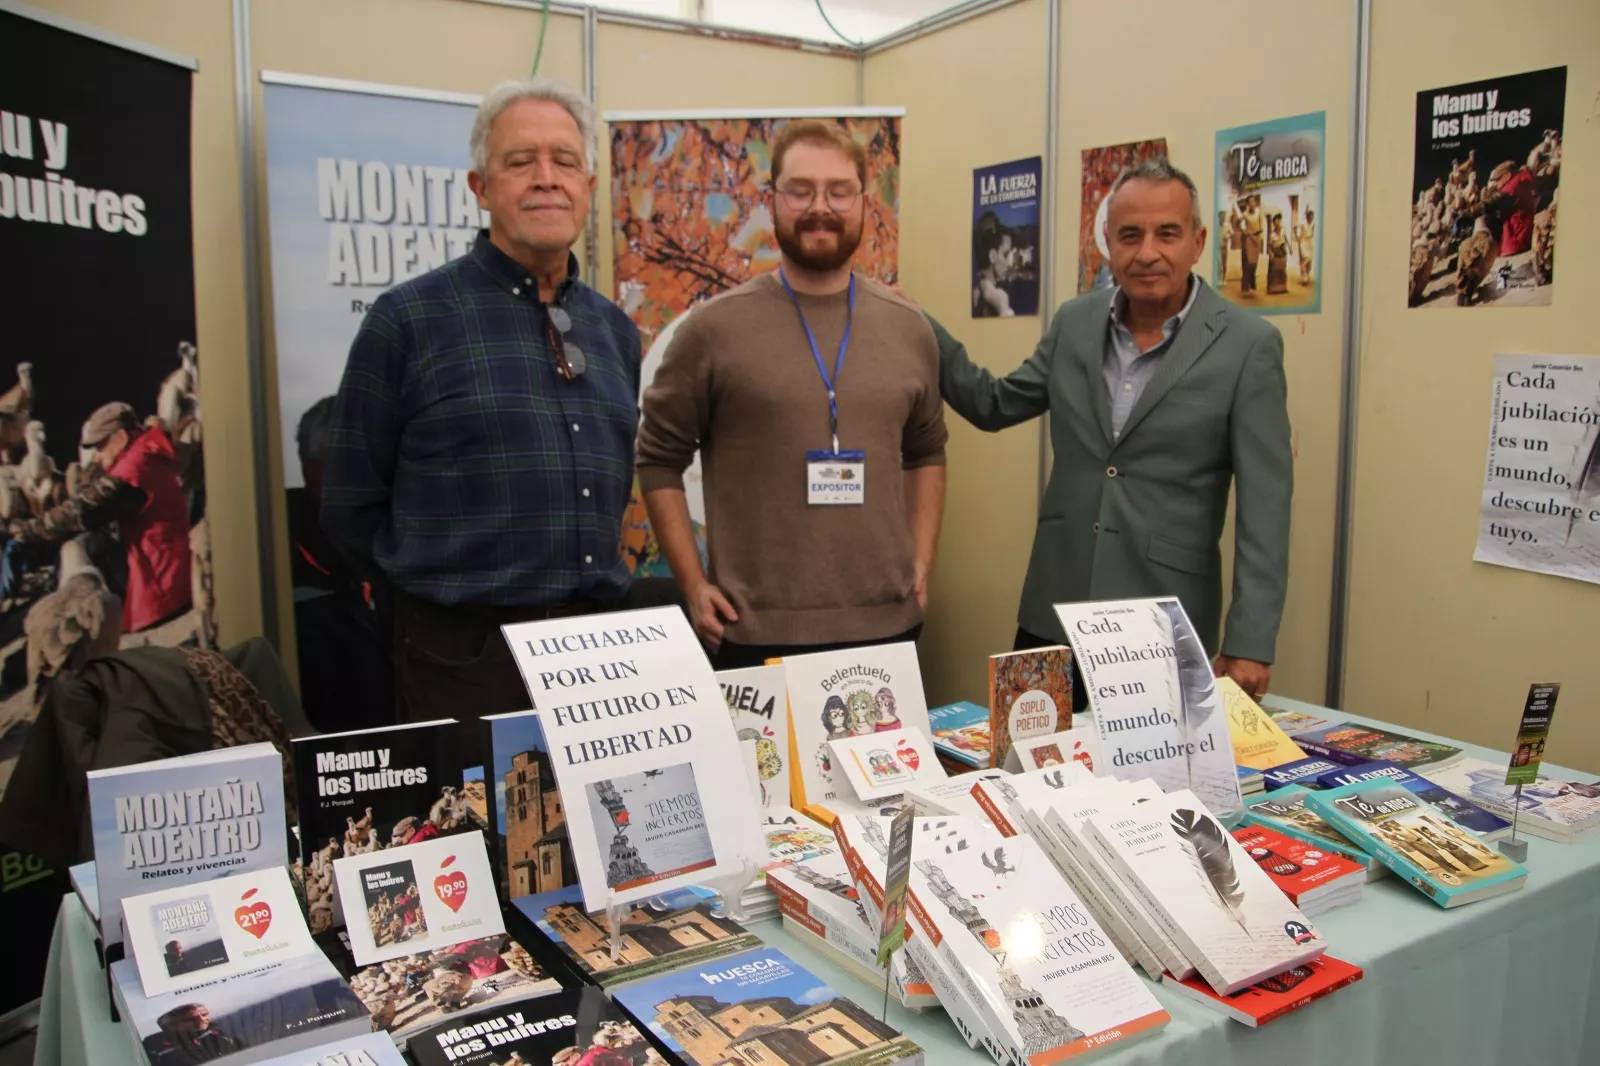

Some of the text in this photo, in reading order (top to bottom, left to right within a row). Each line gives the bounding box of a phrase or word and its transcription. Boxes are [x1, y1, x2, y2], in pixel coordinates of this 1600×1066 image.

[1433, 90, 1498, 117] Manu y
[1432, 108, 1531, 139] los buitres
[38, 118, 68, 171] y
[1230, 140, 1308, 182] Té de ROCA
[981, 172, 1036, 196] LA FUERZA
[1507, 371, 1556, 390] Cada
[1498, 433, 1549, 452] es un
[811, 483, 862, 492] EXPOSITOR
[1495, 464, 1572, 489] mundo,
[1491, 492, 1582, 519] descubre
[1490, 521, 1538, 545] tuyo.
[1077, 617, 1122, 635] Cada
[525, 624, 668, 657] LUCHABAN
[1088, 643, 1177, 672] jubilación
[539, 659, 640, 691] POR UN
[821, 664, 891, 692] Belentuela
[1099, 680, 1146, 698] es un
[552, 685, 698, 727] FUTURO EN
[1019, 699, 1046, 715] SOPLO
[1016, 713, 1049, 733] POÉTICO
[1107, 708, 1178, 733] mundo,
[564, 723, 692, 766] LIBERTAD
[1113, 739, 1195, 767] descubre
[1200, 733, 1216, 752] el
[316, 748, 391, 774] Manu y
[318, 766, 428, 797] los buitres
[1265, 770, 1291, 783] LA
[1334, 774, 1362, 786] LA
[115, 778, 264, 835] MONTAÑA
[645, 792, 698, 817] TIEMPOS
[1073, 808, 1099, 818] CARTA
[1335, 795, 1416, 817] Té de ROCA
[645, 808, 703, 832] INCIERTOS
[1110, 819, 1137, 830] CARTA
[1124, 829, 1135, 838] UN
[1137, 820, 1163, 834] AMIGO
[124, 815, 262, 870] ADENTRO
[645, 834, 664, 842] JAVIER
[1125, 831, 1163, 848] JUBILADO
[141, 856, 247, 880] Relatos y vivencias
[365, 871, 385, 882] Manu
[367, 875, 405, 890] los buitres
[158, 899, 208, 921] MONTAÑA
[163, 911, 210, 932] ADENTRO
[1042, 954, 1115, 982] JAVIER CASAMIÁN BES
[174, 980, 217, 996] Relatos
[307, 1008, 346, 1024] Porquet
[436, 1012, 525, 1048] Manu y
[443, 1013, 578, 1061] los buitres
[1094, 1029, 1122, 1044] Edición
